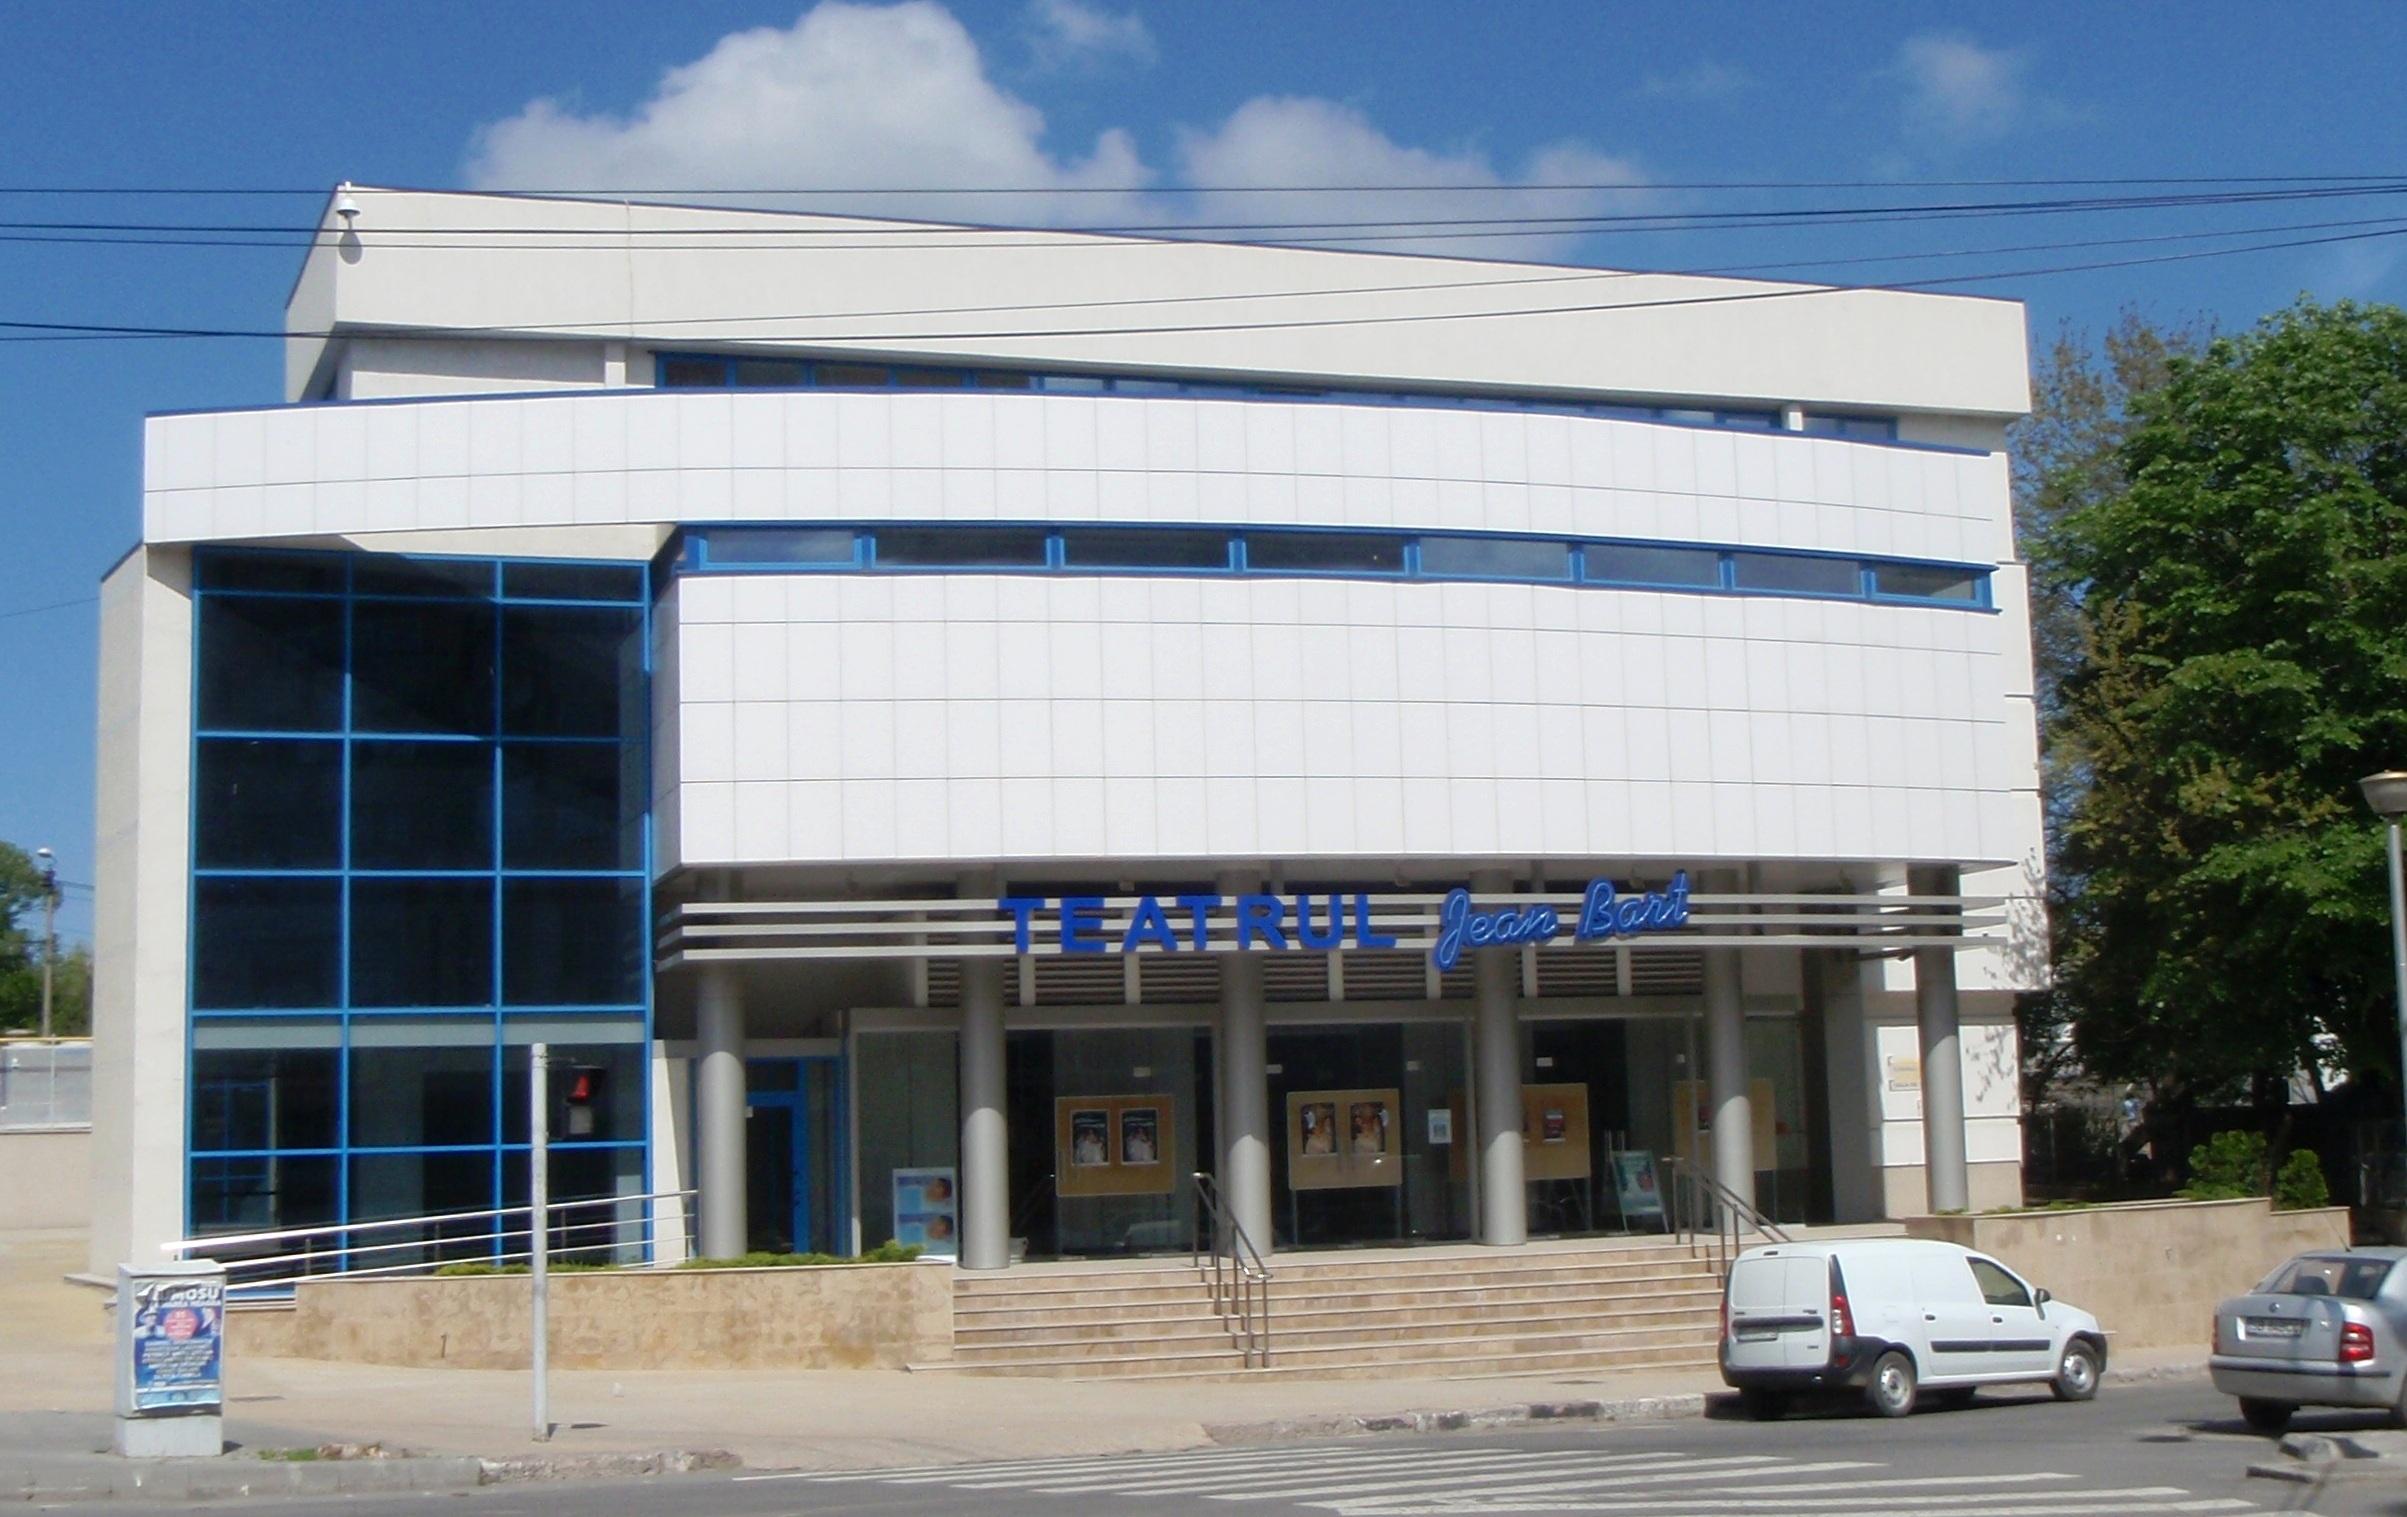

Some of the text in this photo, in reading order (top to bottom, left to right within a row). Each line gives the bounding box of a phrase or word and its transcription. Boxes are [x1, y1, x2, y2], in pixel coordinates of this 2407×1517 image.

[998, 870, 1691, 970] TEATRUL Jean Bart
